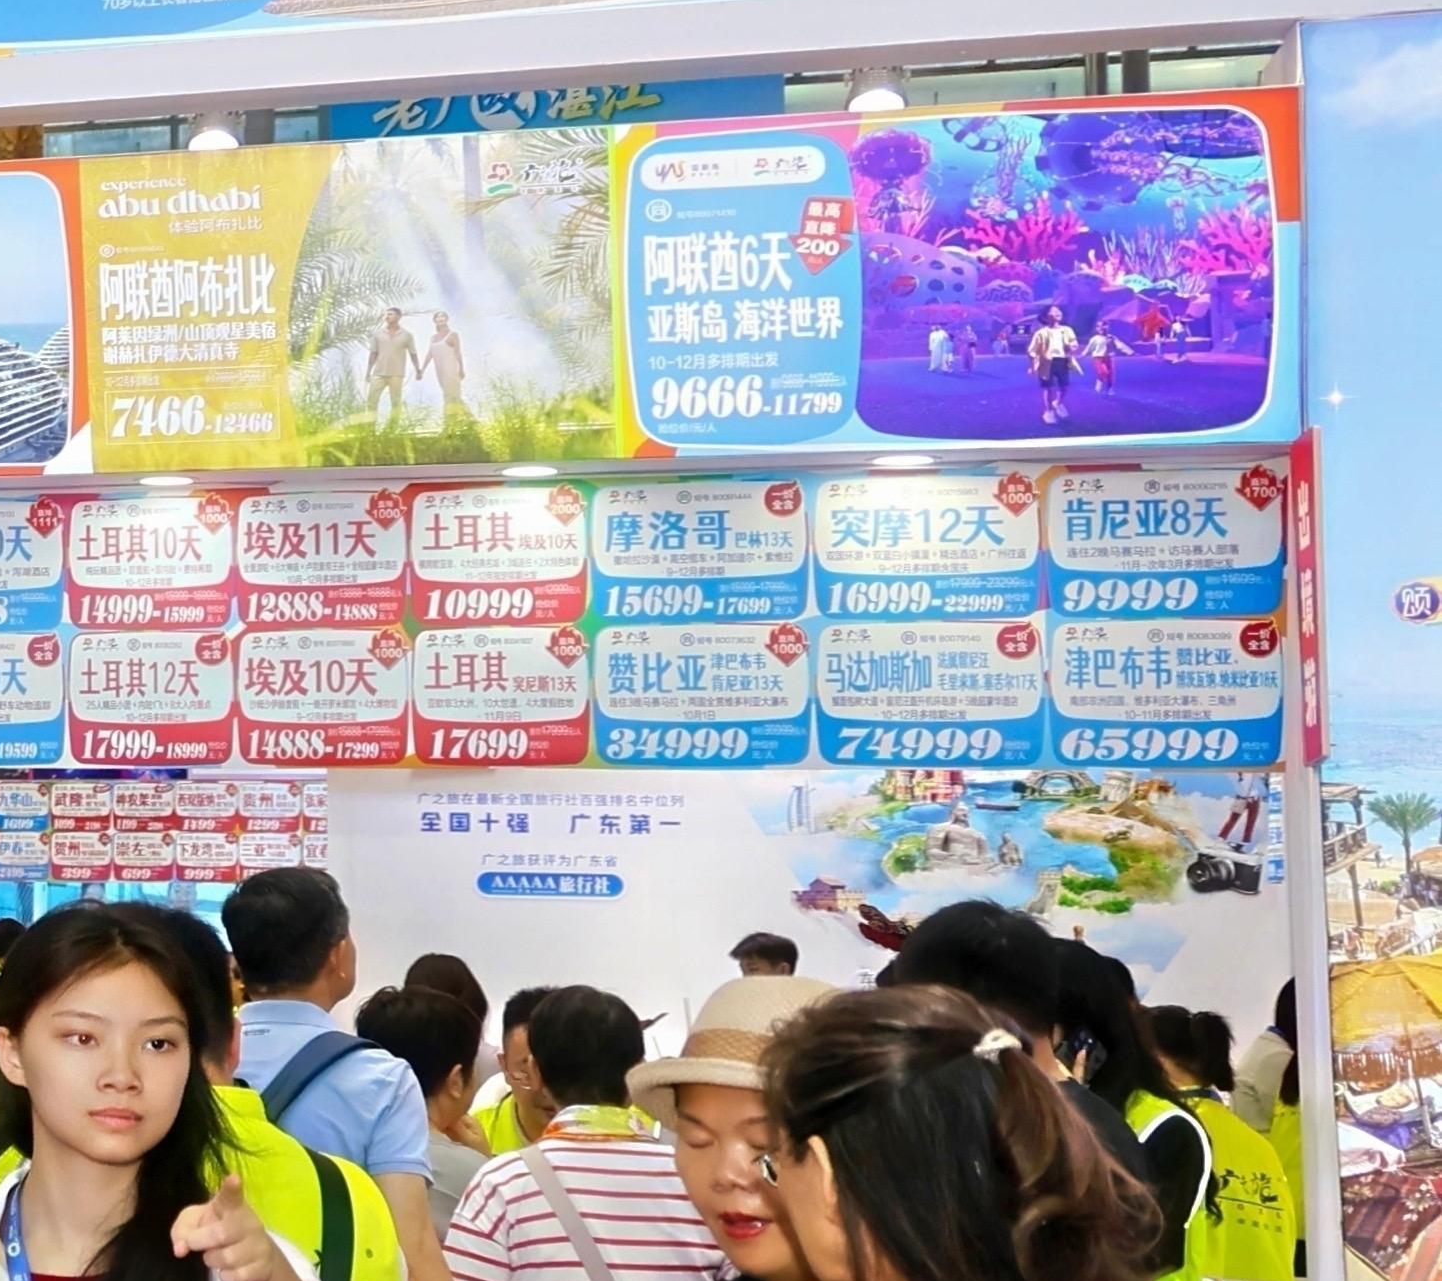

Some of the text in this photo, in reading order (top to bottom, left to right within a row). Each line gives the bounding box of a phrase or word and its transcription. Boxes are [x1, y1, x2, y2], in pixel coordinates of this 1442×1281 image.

[100, 177, 186, 193] experience
[99, 191, 160, 219] abu
[168, 214, 263, 236] 体验阿布扎比
[643, 230, 792, 297] 阿联酋6天
[99, 252, 275, 322] 阿联酋阿布扎比
[647, 296, 843, 346] 亚斯岛 海洋世界
[651, 374, 843, 421] 9666-11799
[112, 392, 274, 438] 7466-12466
[605, 510, 793, 552] 摩洛哥 巴林13天
[830, 505, 1005, 548] 突摩12天
[1063, 498, 1228, 541] 肯尼亚8天
[78, 526, 202, 562] 土耳其10天
[426, 590, 534, 621] 10999
[604, 584, 771, 617] 15699-17699
[1063, 578, 1199, 611] 9999
[1065, 646, 1172, 689] 津巴布韦
[606, 727, 749, 759] 34999
[1060, 728, 1239, 761] 65999
[420, 810, 681, 835] 全国十强 广东第一
[491, 874, 611, 896] AAAAA 旅行社
